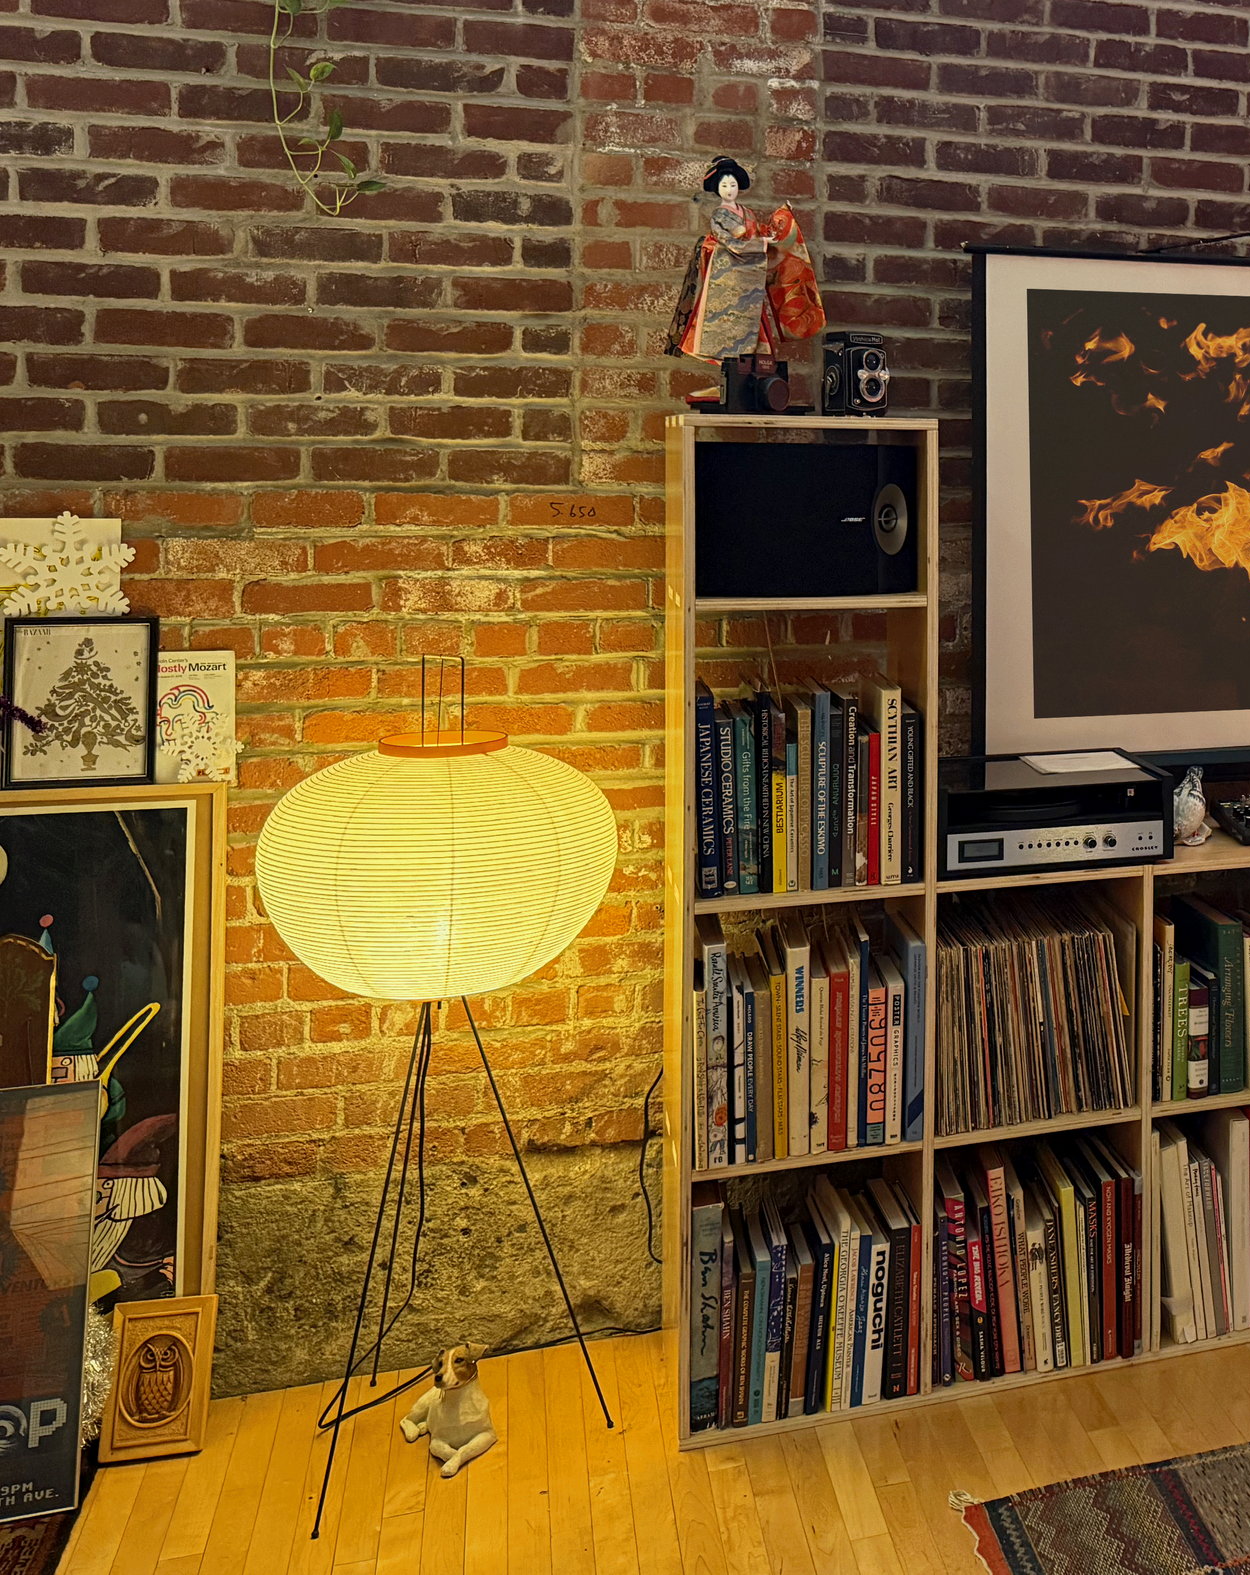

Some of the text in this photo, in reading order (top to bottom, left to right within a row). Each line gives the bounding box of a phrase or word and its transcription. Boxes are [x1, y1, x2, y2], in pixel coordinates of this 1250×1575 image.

[24, 628, 51, 636] BAZAAR
[189, 663, 227, 672] Mozart
[846, 706, 857, 834] Creation and Transformation
[888, 698, 898, 792] SCYTHIAN ART
[698, 724, 714, 856] JAPANESE CERAMICS
[720, 727, 734, 834] STUDIO CERAMICS
[742, 752, 752, 830] Gifts from the Fire
[817, 742, 826, 855] SCULPTURE OF THE ESKIMO
[762, 810, 769, 818] IN
[776, 782, 784, 834] BESTIARIUM
[1178, 983, 1188, 1038] TREES
[1222, 956, 1234, 1047] Arranging Flowers
[990, 1176, 1010, 1288] EIKO ISHIOKA
[1088, 1200, 1097, 1238] MASKS
[1186, 1201, 1194, 1227] Makeup
[821, 1268, 829, 1284] Neel,
[839, 1251, 847, 1292] GEORGIA
[954, 1205, 968, 1298] ANTONIO LOPEZ
[1018, 1232, 1030, 1314] WHAT PEOPLE WORE
[1123, 1242, 1132, 1302] Medieval Knight
[700, 1248, 718, 1356] Ben Shahn
[722, 1289, 732, 1340] BEN SHAHN
[837, 1294, 846, 1339] O'KEEFFE
[870, 1250, 887, 1350] noguchi
[893, 1244, 905, 1356] ELIZABETH CATLETT
[1052, 1294, 1061, 1324] FANCY
[740, 1366, 746, 1374] OF
[834, 1341, 843, 1380] MUSEUM
[846, 1342, 854, 1370] PAINTER
[23, 1488, 60, 1502] AVE.
